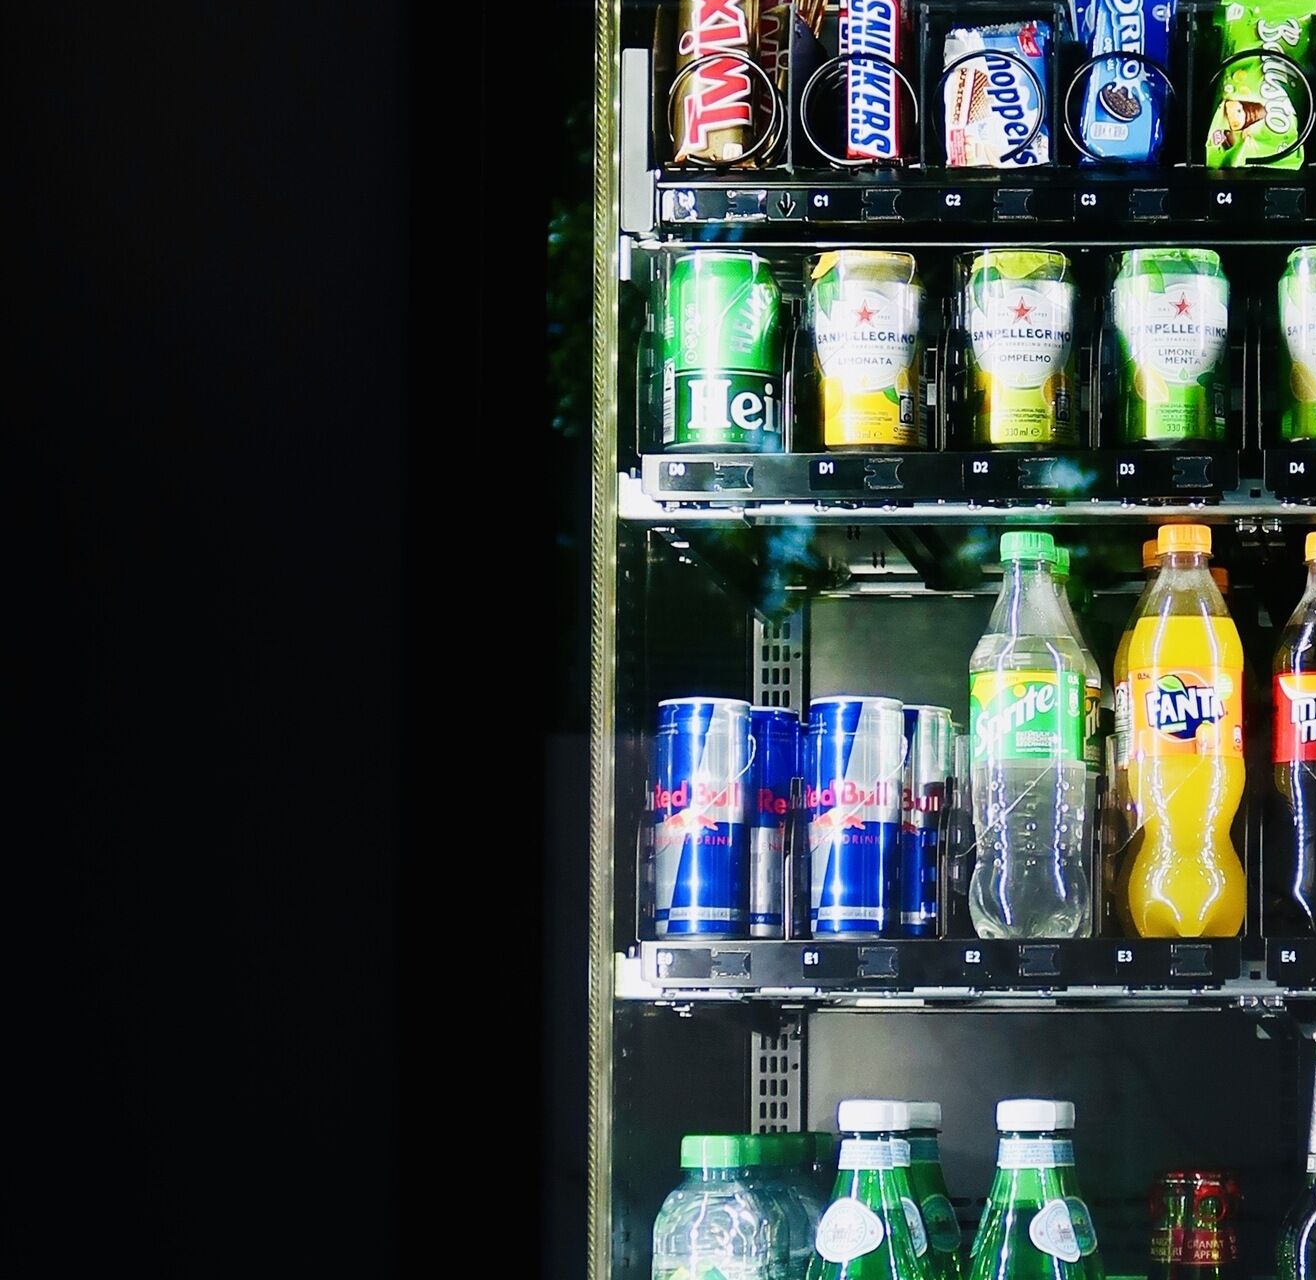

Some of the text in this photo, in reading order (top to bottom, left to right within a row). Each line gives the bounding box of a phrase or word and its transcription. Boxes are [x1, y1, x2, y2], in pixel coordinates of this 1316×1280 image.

[985, 53, 1038, 165] noppers
[813, 194, 829, 207] C1
[945, 194, 961, 206] C2
[1081, 194, 1097, 206] C3
[1216, 192, 1232, 204] C4
[818, 461, 834, 475] D1
[972, 461, 989, 474] D2
[1119, 463, 1136, 475] D3
[1289, 462, 1305, 474] D4
[1145, 685, 1225, 728] FANTA
[975, 684, 1056, 758] Sprite
[695, 781, 740, 808] Bull
[841, 781, 889, 807] Bull
[803, 952, 819, 965] E1
[965, 950, 981, 964] E2
[1117, 950, 1133, 963] E3
[1281, 951, 1297, 963] E4
